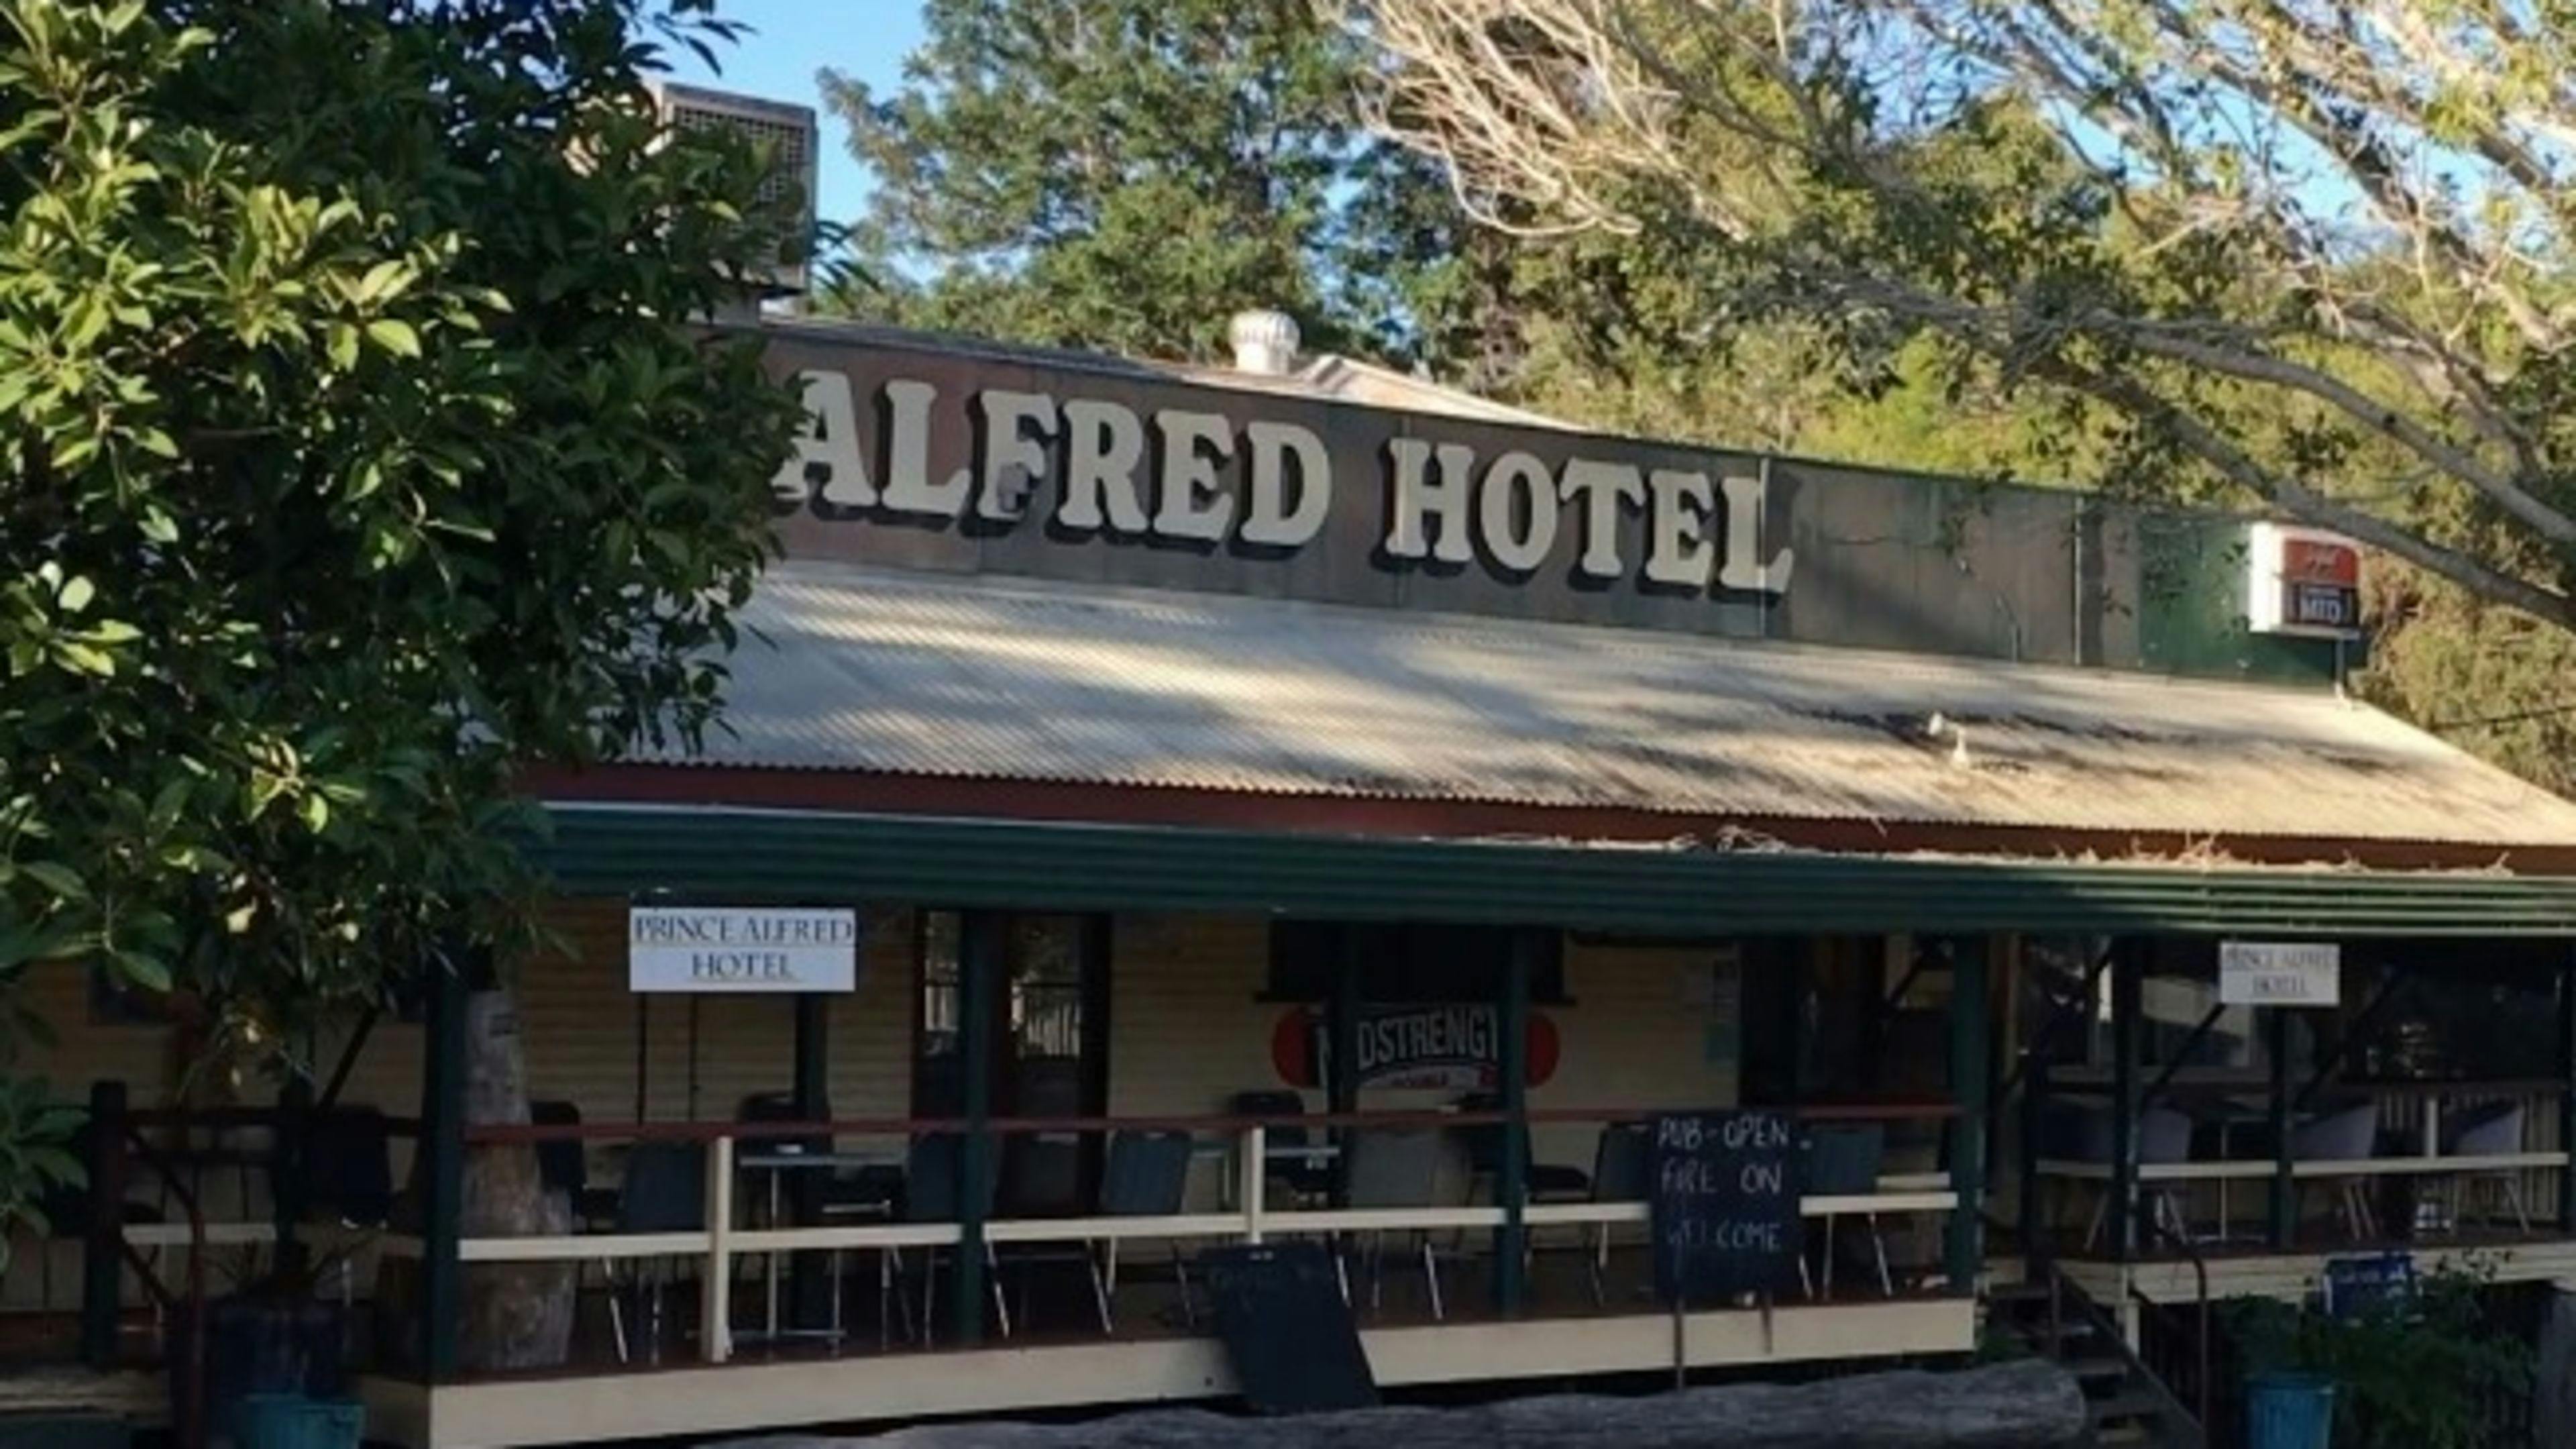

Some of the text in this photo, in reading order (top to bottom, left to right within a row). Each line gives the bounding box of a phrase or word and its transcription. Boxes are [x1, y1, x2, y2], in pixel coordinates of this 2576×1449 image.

[770, 369, 1794, 594] ALFRED HOTEL
[635, 916, 853, 942] PRINCE ALFRED
[691, 951, 794, 977] HOTEL
[1740, 1163, 1782, 1194] ON
